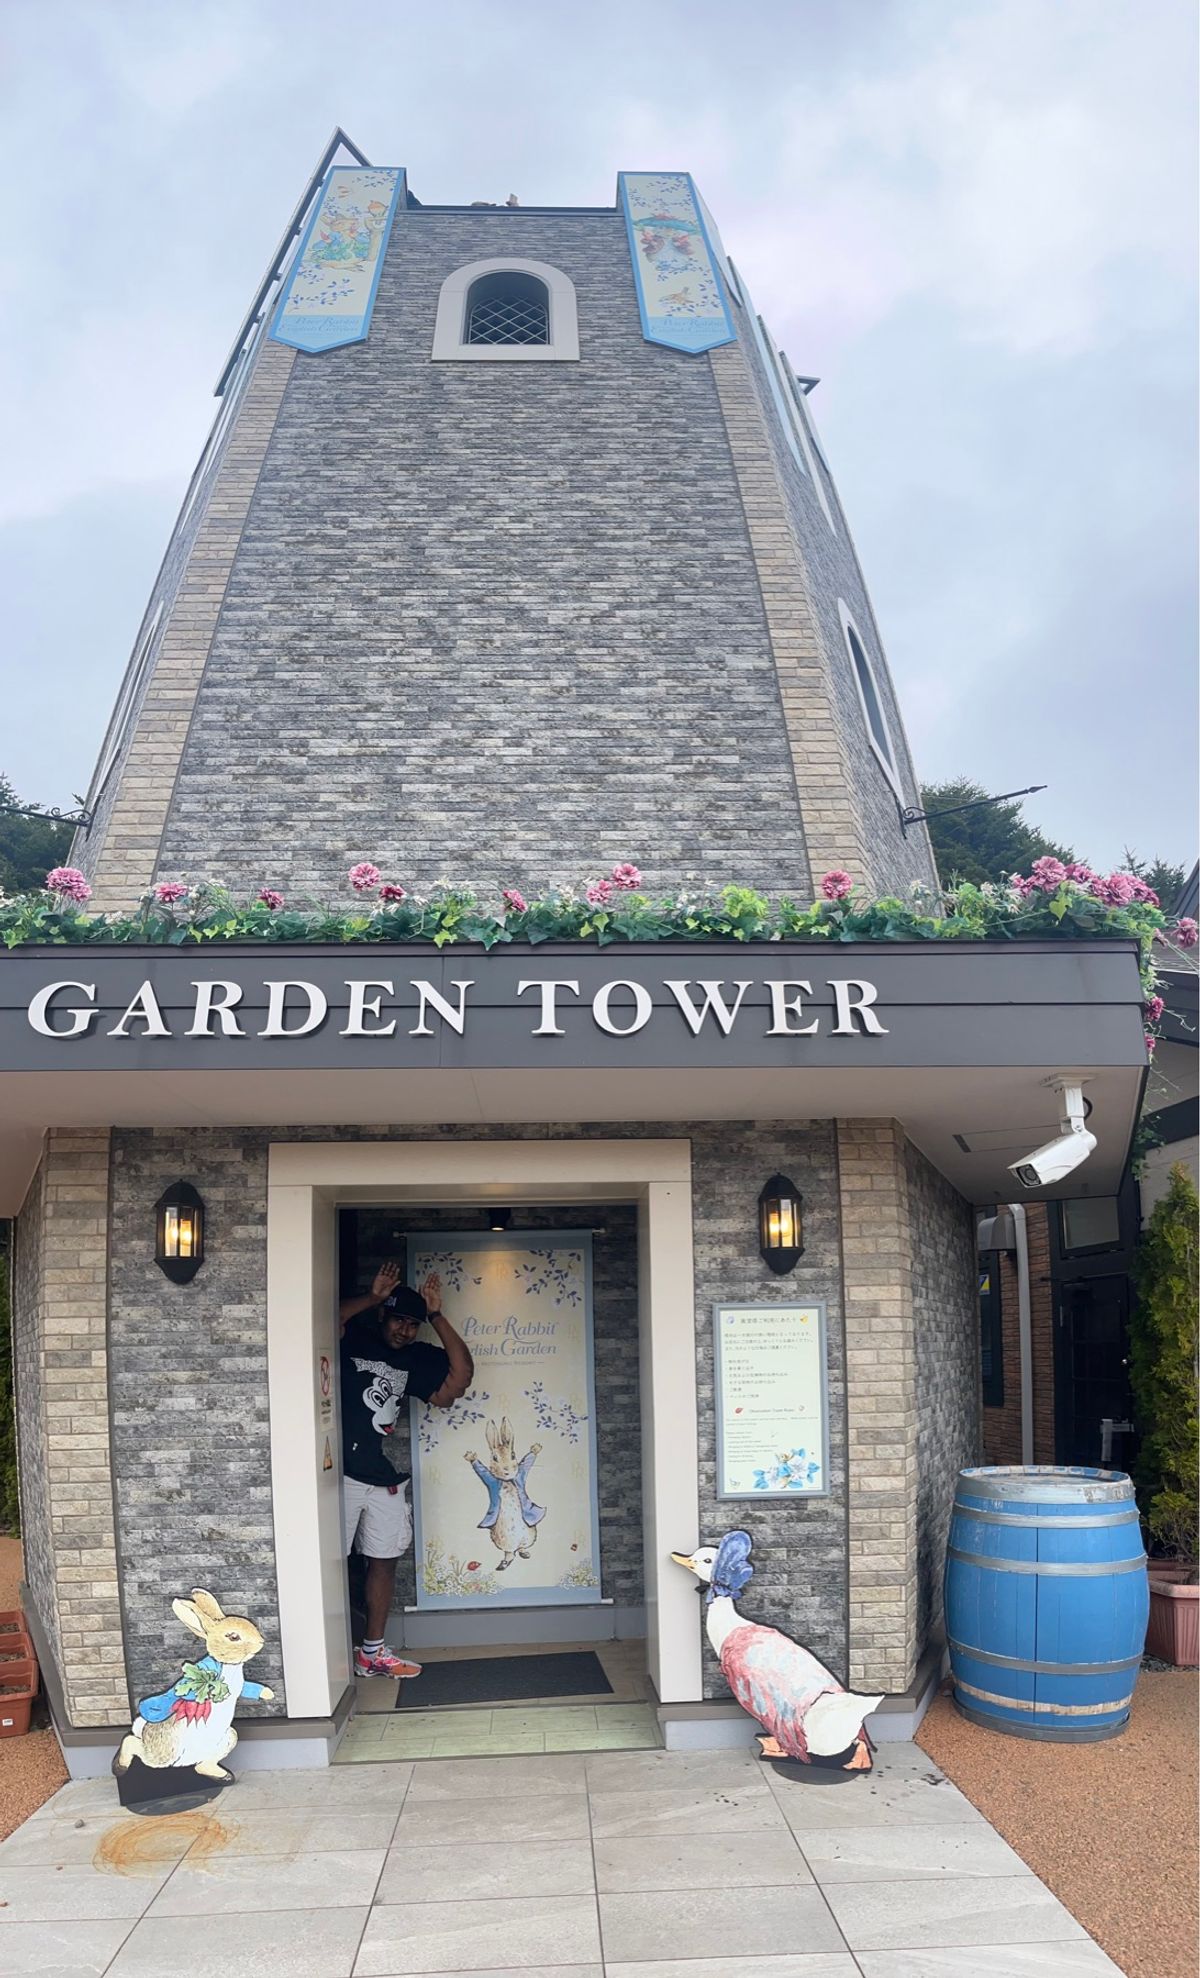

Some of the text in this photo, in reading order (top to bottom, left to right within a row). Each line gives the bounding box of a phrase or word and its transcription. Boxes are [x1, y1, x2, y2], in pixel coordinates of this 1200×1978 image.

[27, 978, 891, 1039] GARDEN TOWER
[462, 1314, 557, 1341] Peter Rabbit
[467, 1339, 556, 1356] lish Garden
